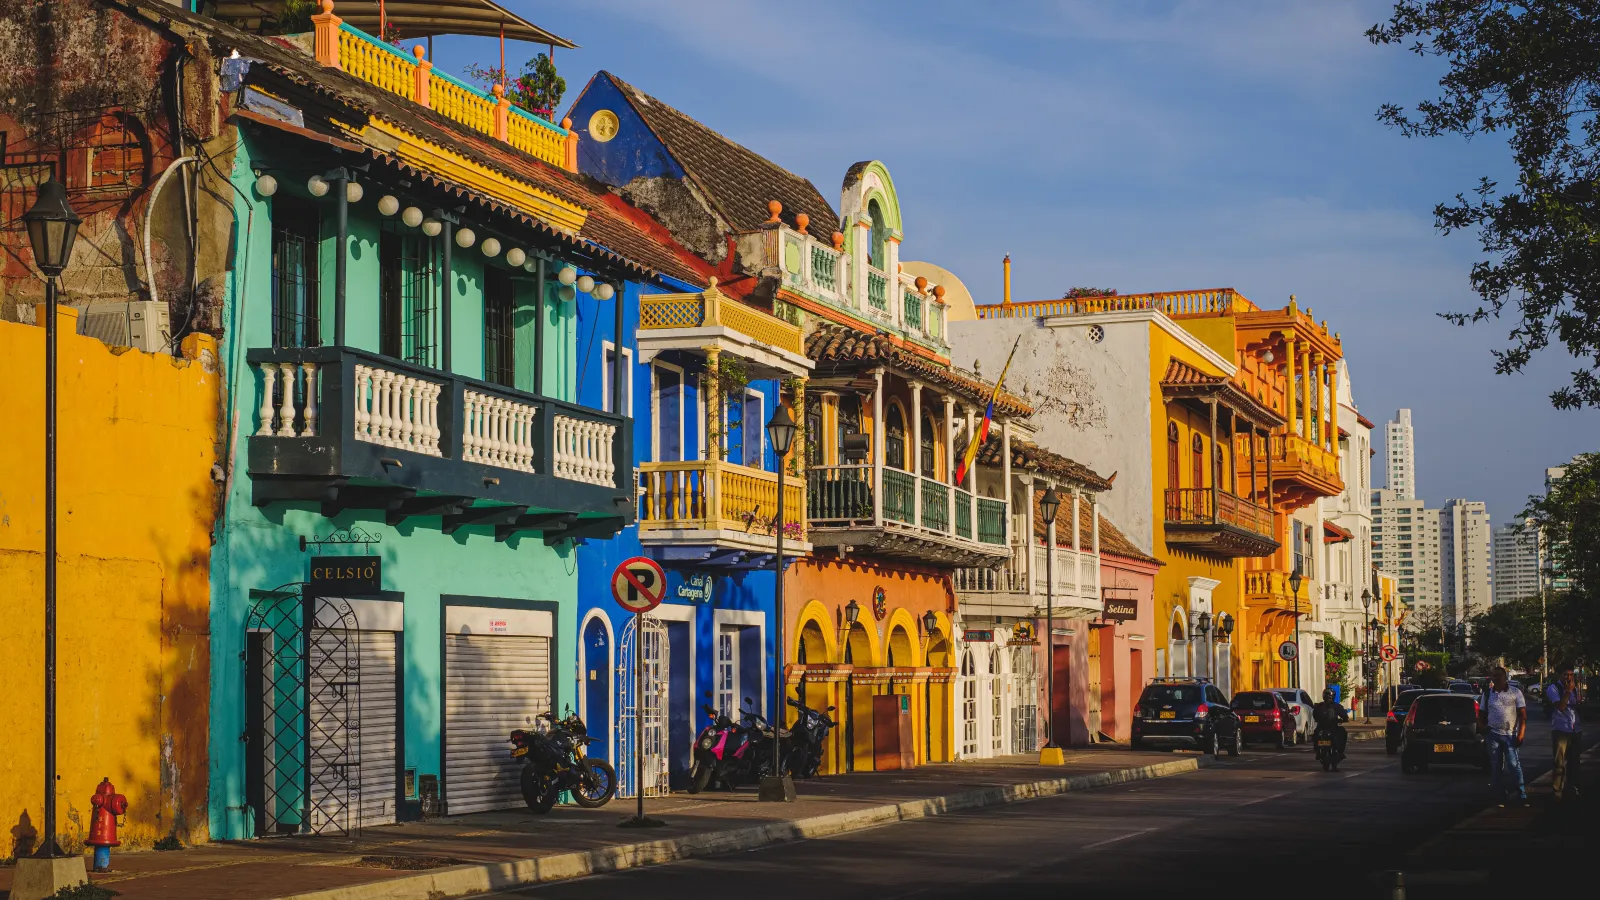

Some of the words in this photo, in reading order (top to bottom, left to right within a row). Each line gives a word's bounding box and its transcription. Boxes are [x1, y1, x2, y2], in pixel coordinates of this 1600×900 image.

[628, 569, 654, 601] P
[691, 574, 704, 587] Canal
[678, 585, 703, 601] Cartagena
[1107, 604, 1135, 615] Selina
